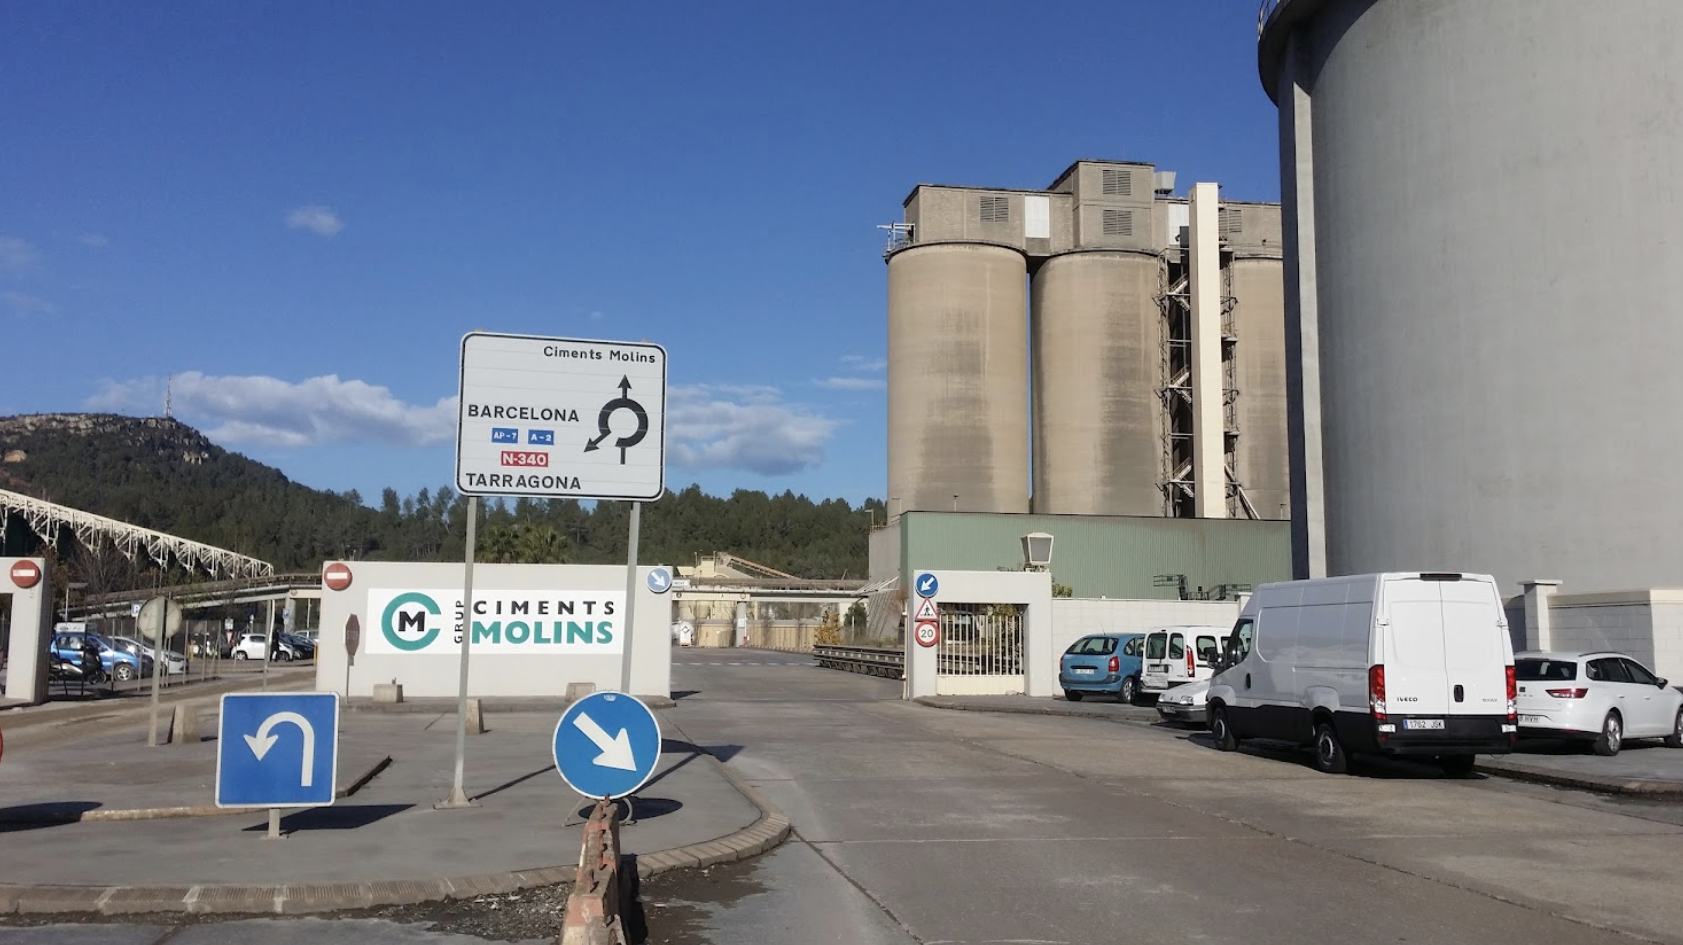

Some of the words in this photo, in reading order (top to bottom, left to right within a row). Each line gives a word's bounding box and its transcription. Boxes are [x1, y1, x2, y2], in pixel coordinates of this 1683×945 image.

[543, 346, 602, 360] Ciments
[609, 350, 656, 363] Molins
[468, 404, 580, 422] BARCELONA
[493, 431, 517, 440] AP-7
[530, 433, 552, 442] A-2
[502, 453, 547, 466] N-340
[465, 473, 581, 490] TARRAGONA
[473, 600, 615, 615] CIMENTS
[454, 600, 464, 644] GRUP
[471, 621, 613, 644] MOLINS
[920, 629, 934, 638] 20
